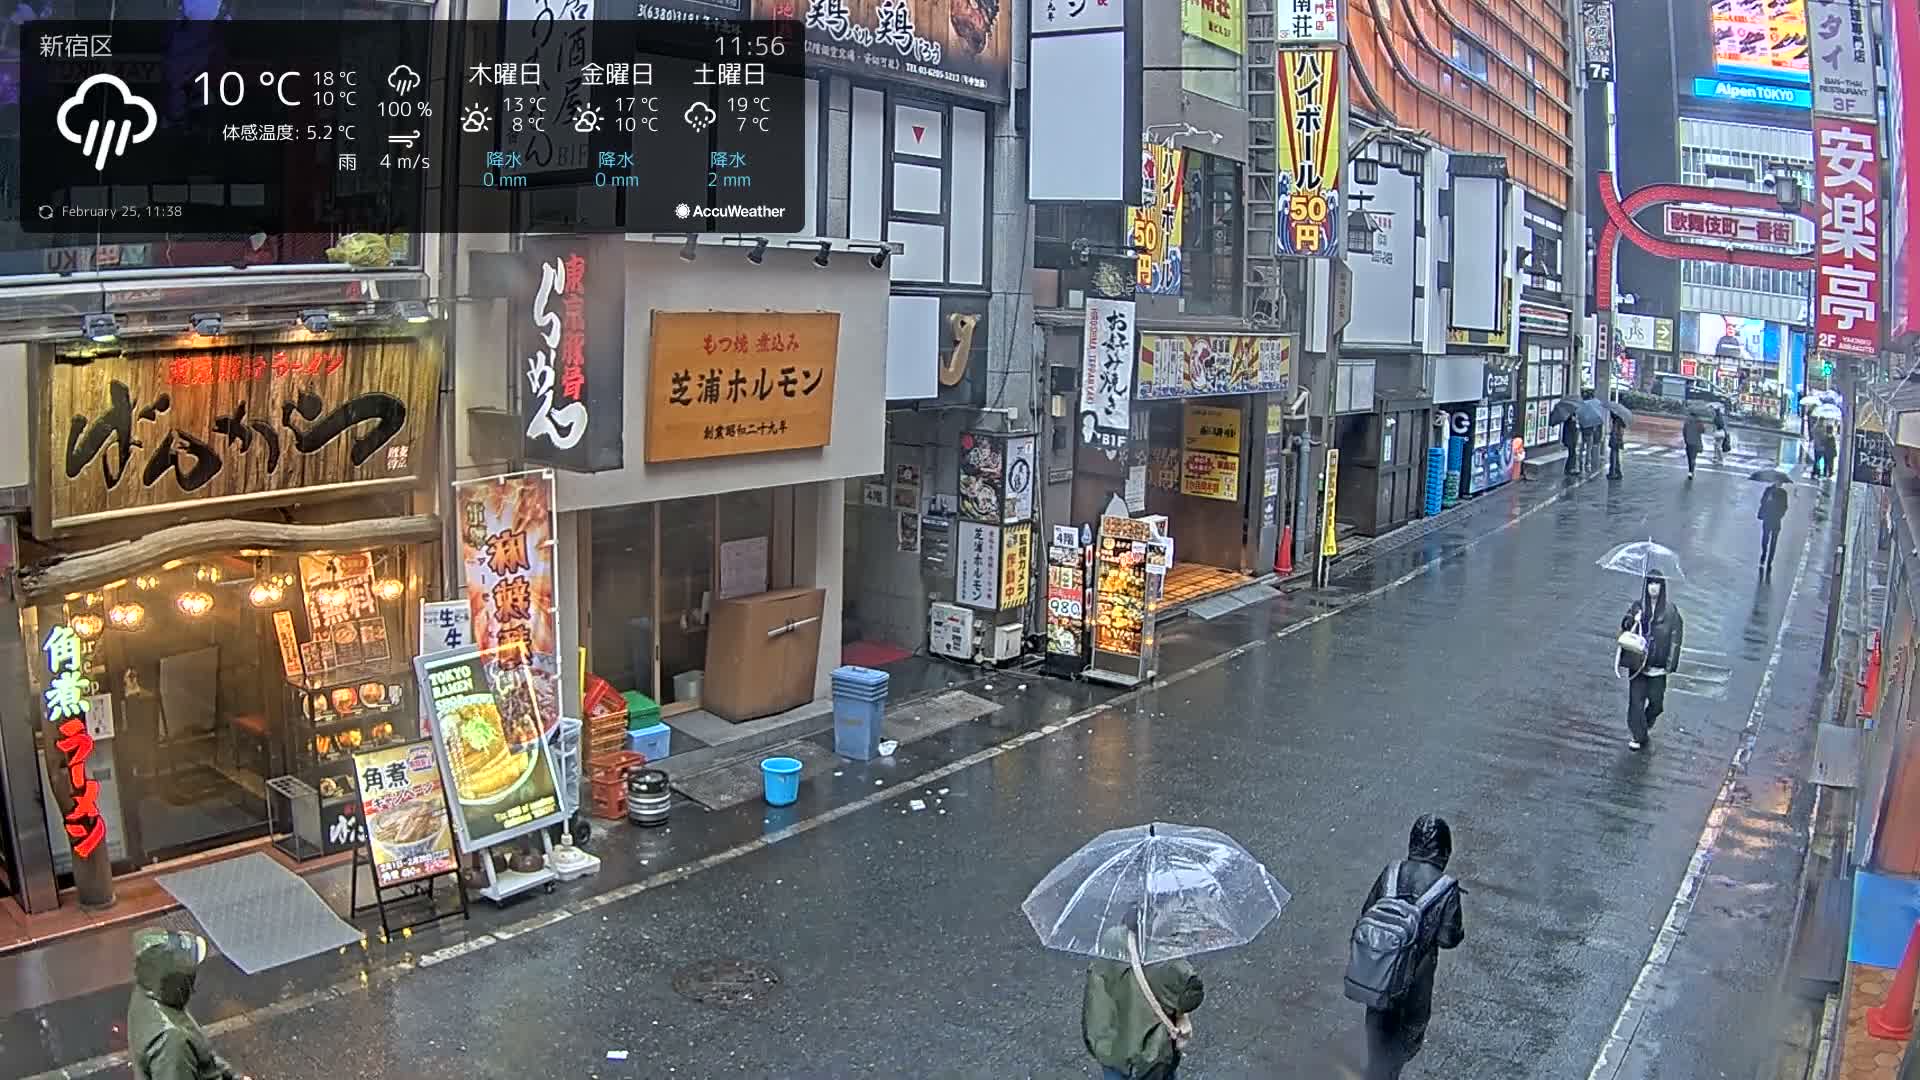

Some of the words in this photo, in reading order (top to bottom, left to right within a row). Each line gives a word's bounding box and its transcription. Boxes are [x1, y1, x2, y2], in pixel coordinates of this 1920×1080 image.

[1589, 63, 1611, 79] 7F
[1715, 83, 1756, 97] Alpen
[1756, 87, 1795, 102] TOKYO
[1832, 98, 1857, 113] 3F
[1296, 54, 1323, 191] ハイボール
[1290, 196, 1327, 221] 50
[1134, 220, 1157, 250] 50
[1295, 225, 1320, 251] 円
[1670, 211, 1791, 243] 歌舞伎町一番街
[1819, 127, 1877, 331] 安楽亭
[562, 254, 585, 400] 東京豚骨
[1818, 332, 1837, 347] 2F
[703, 334, 749, 355] もつ焼
[755, 332, 800, 353] 煮込み
[1101, 310, 1129, 416] お好み焼き
[670, 366, 824, 405] 芝浦ホルモン
[703, 420, 788, 440] 創業昭和二十九年
[1101, 432, 1127, 448] B1F
[1056, 530, 1074, 546] 4階
[1050, 600, 1081, 616] 980
[43, 625, 91, 721] 角煮
[428, 665, 471, 686] TOKYO
[432, 677, 474, 700] RAMEN
[56, 718, 107, 858] ラーメン
[362, 761, 409, 793] 角煮
